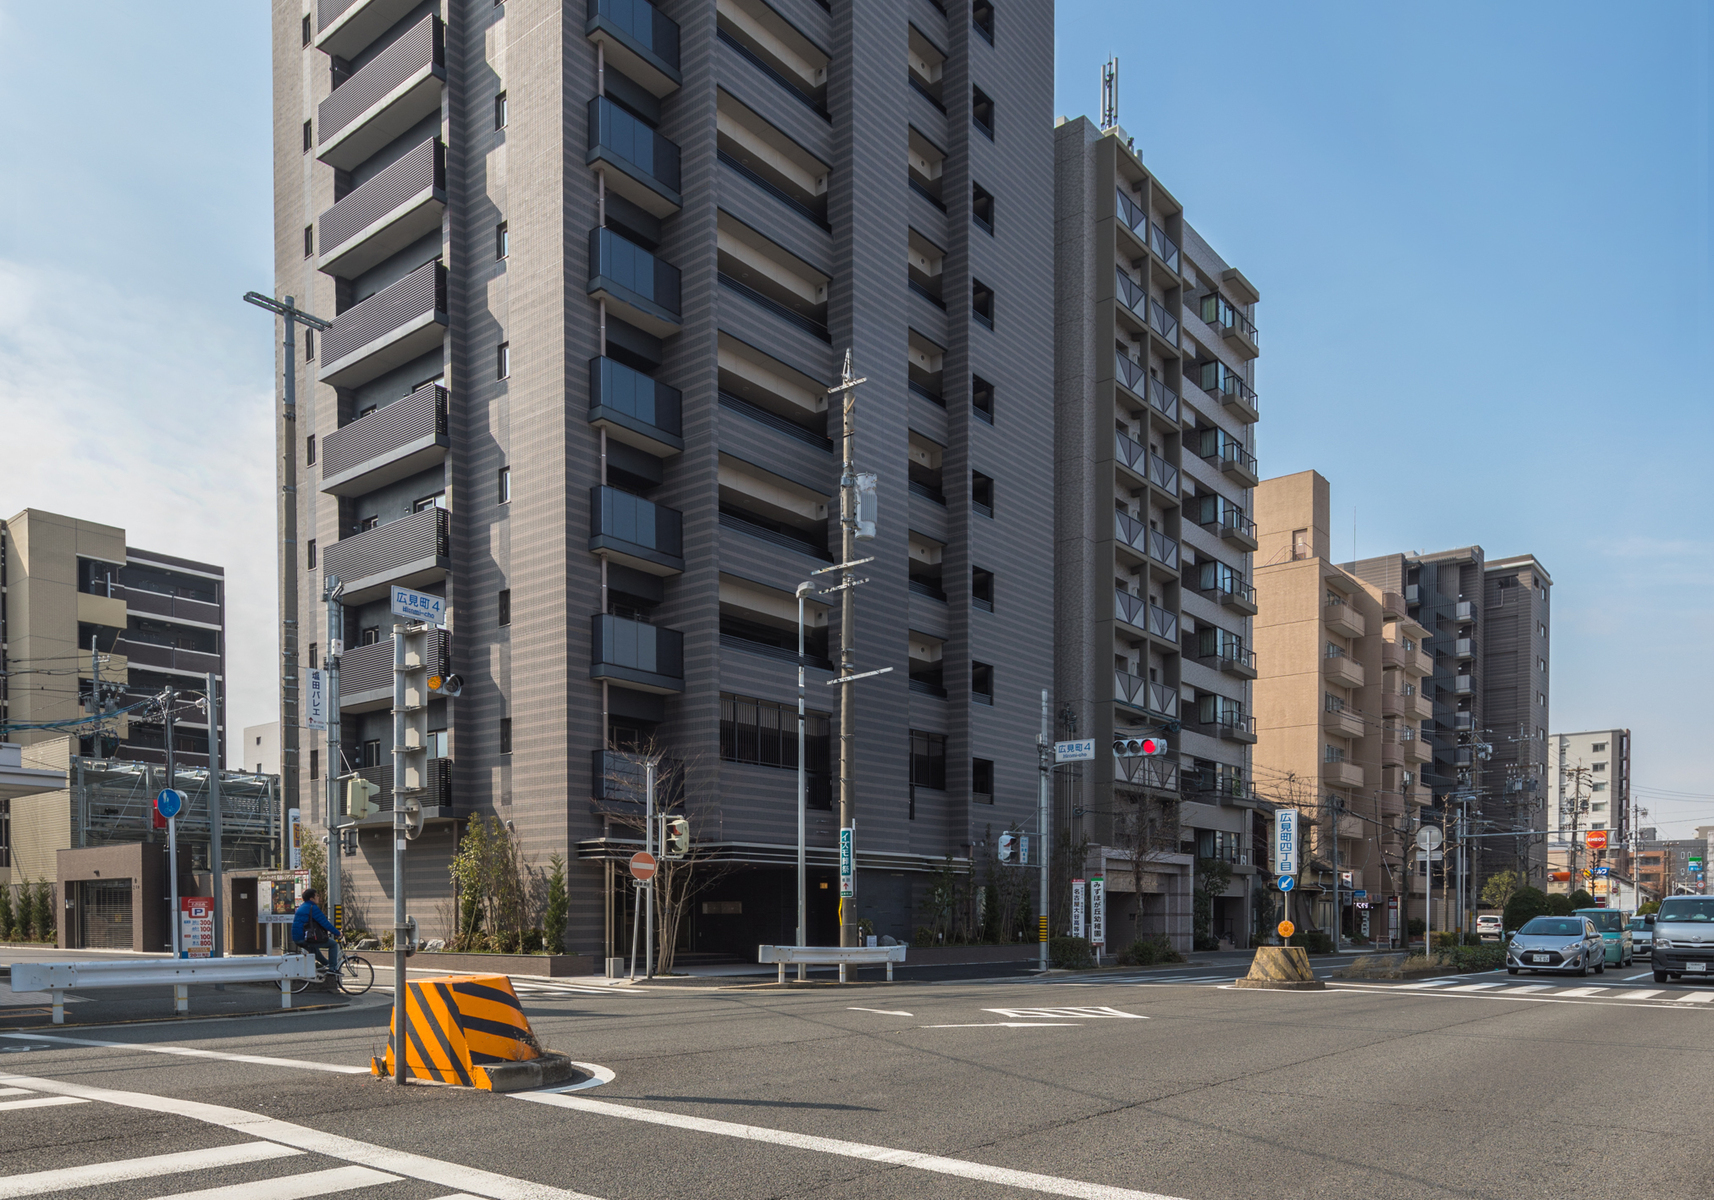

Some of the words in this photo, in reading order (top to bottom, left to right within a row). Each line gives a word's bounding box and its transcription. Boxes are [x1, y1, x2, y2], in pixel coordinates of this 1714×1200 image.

[397, 592, 440, 612] 広見町4
[1058, 743, 1091, 753] 広見町4
[1280, 813, 1292, 871] 広見町四丁目
[1094, 882, 1102, 937] みずほが丘幼稚園
